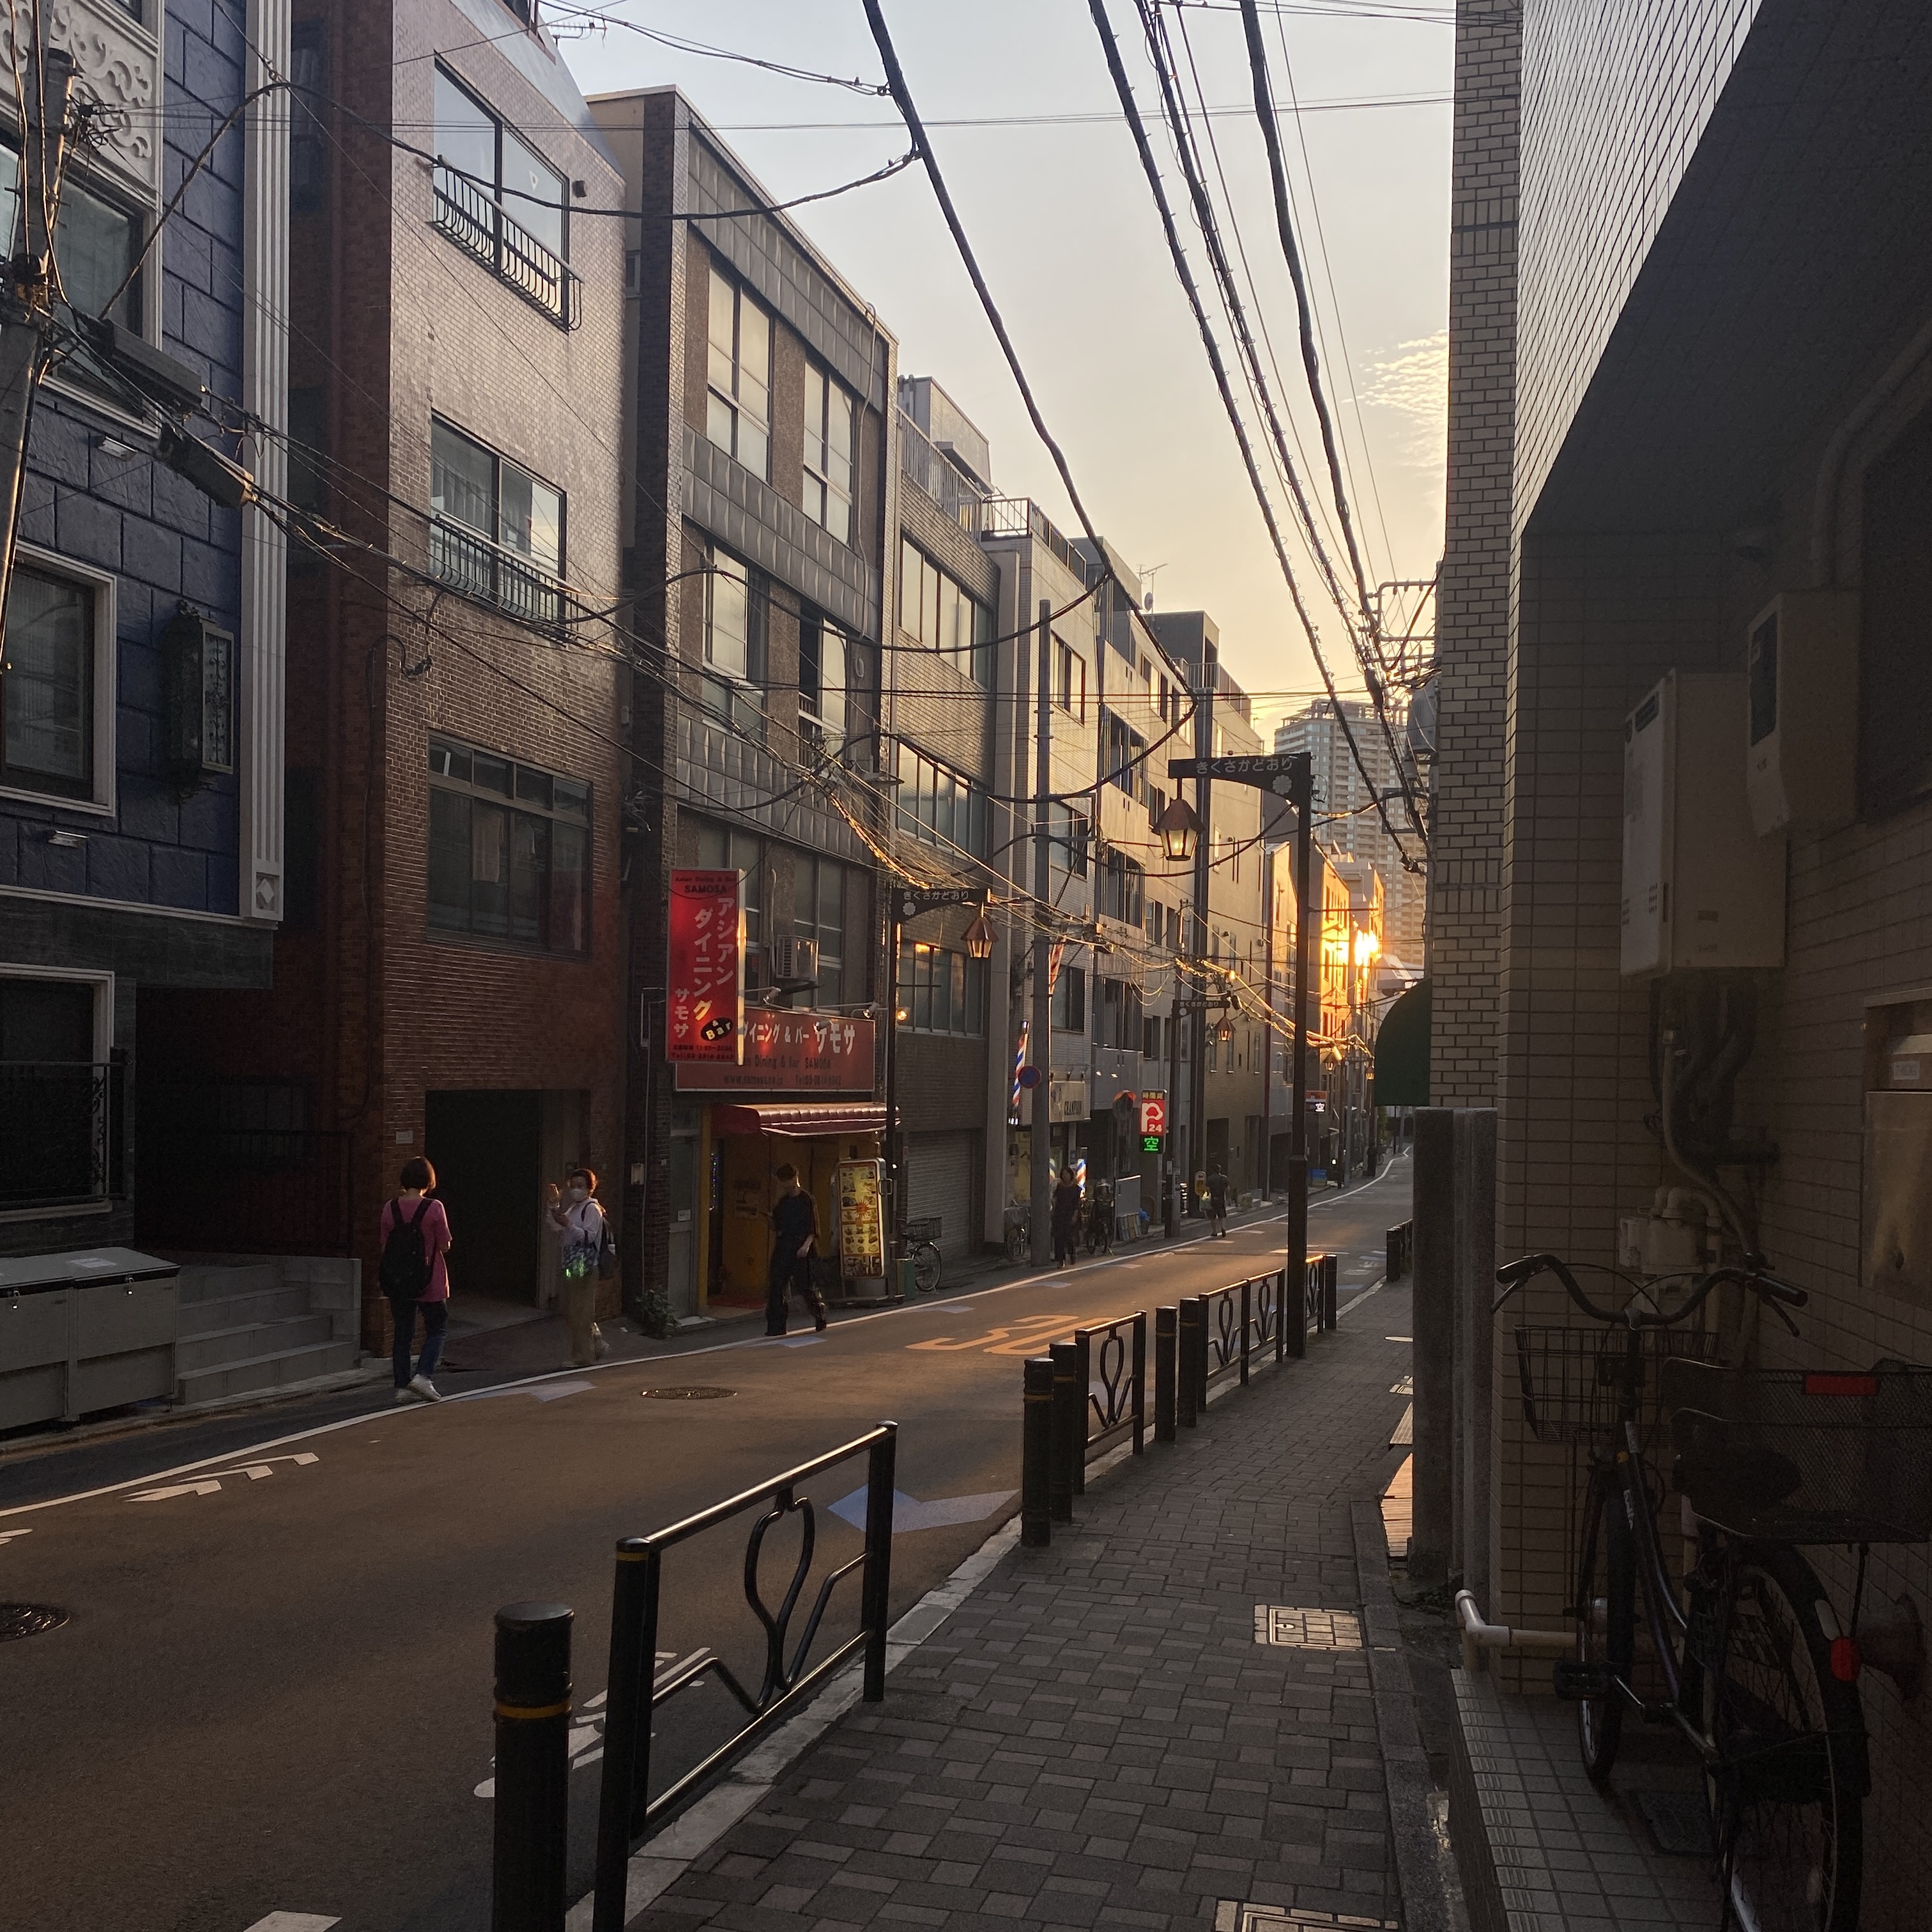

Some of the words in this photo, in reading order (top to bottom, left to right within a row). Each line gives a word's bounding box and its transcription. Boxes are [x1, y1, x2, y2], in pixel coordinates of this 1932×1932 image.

[1196, 757, 1293, 774] きくさかどおり
[685, 885, 727, 893] SAMOSA
[716, 897, 735, 986] アジアン
[693, 908, 714, 1022] ダイニング
[674, 988, 690, 1038] サモサ
[706, 1022, 731, 1040] Bar
[785, 1025, 791, 1043] &
[795, 1025, 809, 1044] バー
[814, 1023, 855, 1055] サモサ
[755, 1054, 777, 1070] Dining
[805, 1057, 831, 1070] SAMOSA
[1148, 1124, 1163, 1133] 24
[1143, 1135, 1160, 1152] 空
